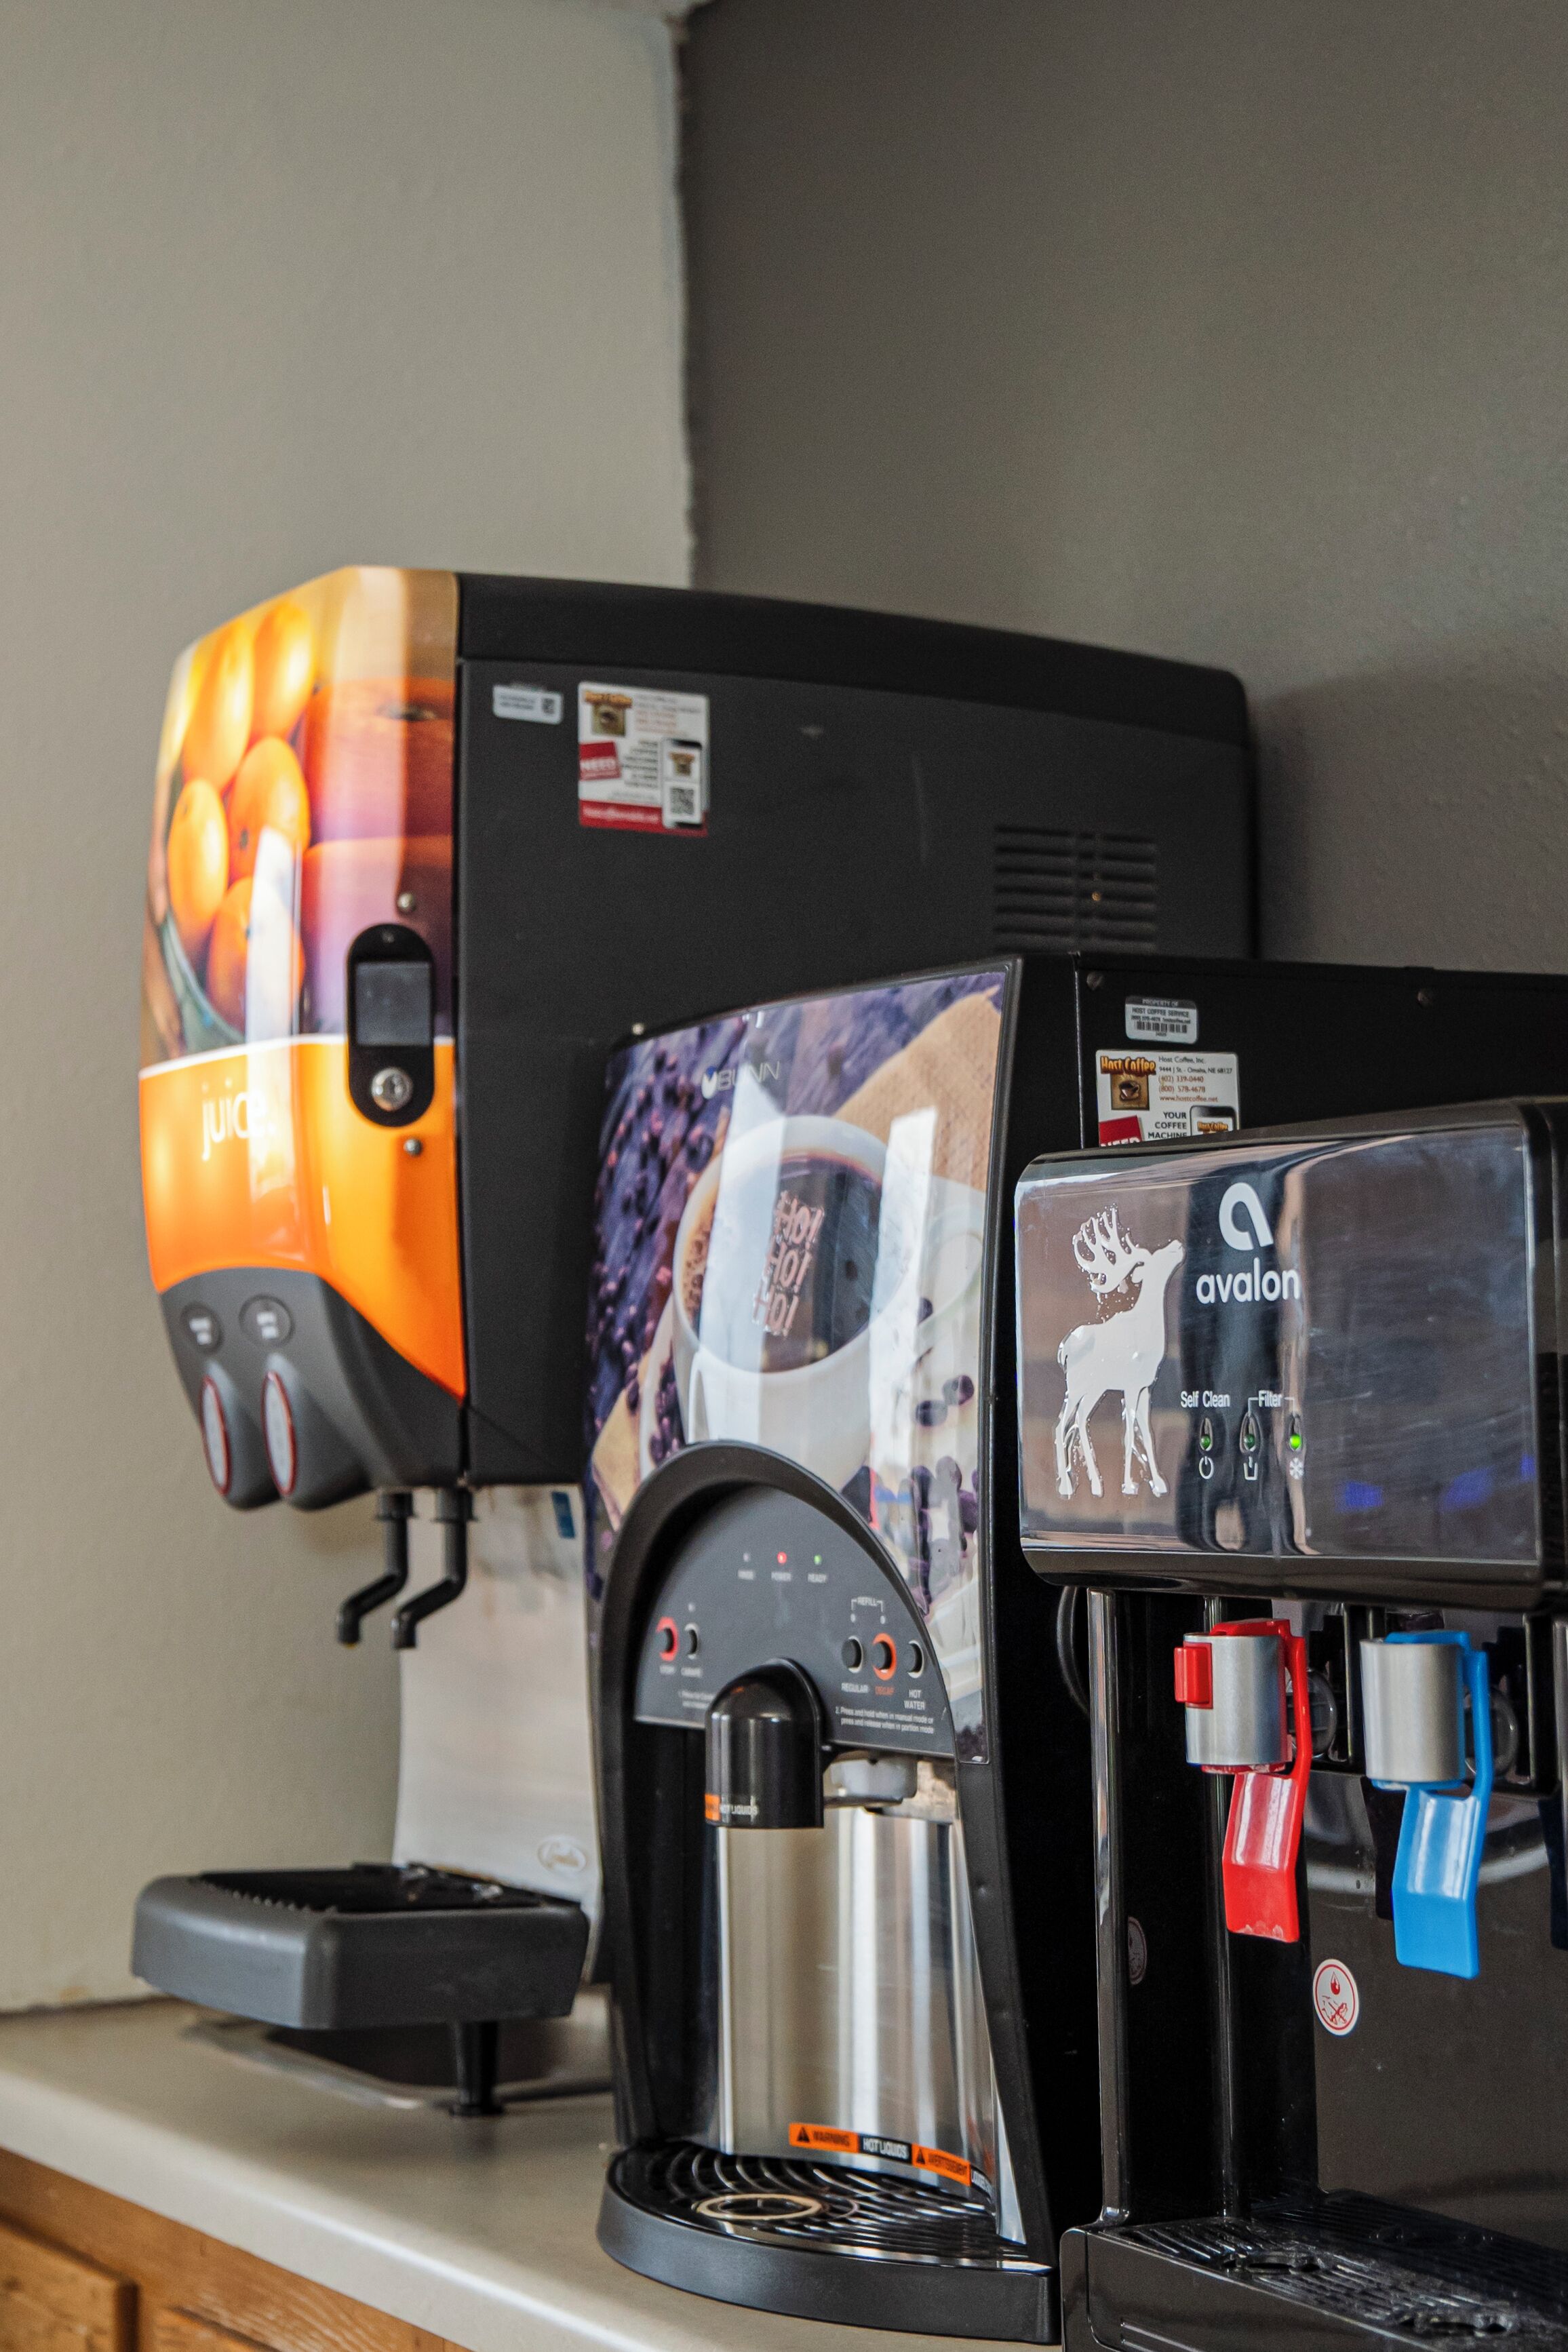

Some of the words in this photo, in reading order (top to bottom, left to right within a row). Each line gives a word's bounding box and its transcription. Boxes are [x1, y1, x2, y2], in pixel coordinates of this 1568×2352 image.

[1168, 1010, 1189, 1018] SERVICE
[1100, 1056, 1123, 1073] Host
[1124, 1056, 1156, 1074] Coffee
[1159, 1085, 1175, 1094] (800)
[1160, 1095, 1218, 1103] www.hostcoffee.net
[1163, 1112, 1187, 1120] YOUR
[762, 1234, 812, 1293] HO!
[1196, 1257, 1300, 1304] avalon
[751, 1279, 800, 1337] HO!
[1181, 1390, 1199, 1407] Self
[1202, 1390, 1230, 1407] Clean
[1259, 1390, 1282, 1407] Filter
[808, 1573, 827, 1584] READY
[857, 1596, 878, 1607] REFILL
[841, 1683, 869, 1694] REGULAR
[875, 1686, 895, 1696] DECAF
[909, 1689, 922, 1699] HOT
[904, 1700, 926, 1710] WATER
[840, 1706, 854, 1717] Press
[855, 1708, 864, 1717] and
[864, 1709, 875, 1718] hold
[876, 1711, 888, 1719] when
[895, 1713, 913, 1722] manual
[913, 1715, 927, 1724] mode
[864, 1719, 882, 1729] release
[882, 1721, 895, 1729] when
[901, 1724, 919, 1732] portion
[920, 1725, 933, 1734] mode
[812, 2130, 850, 2146] WARNING
[863, 2137, 879, 2153] HOT
[880, 2140, 907, 2159] LIQUIDS
